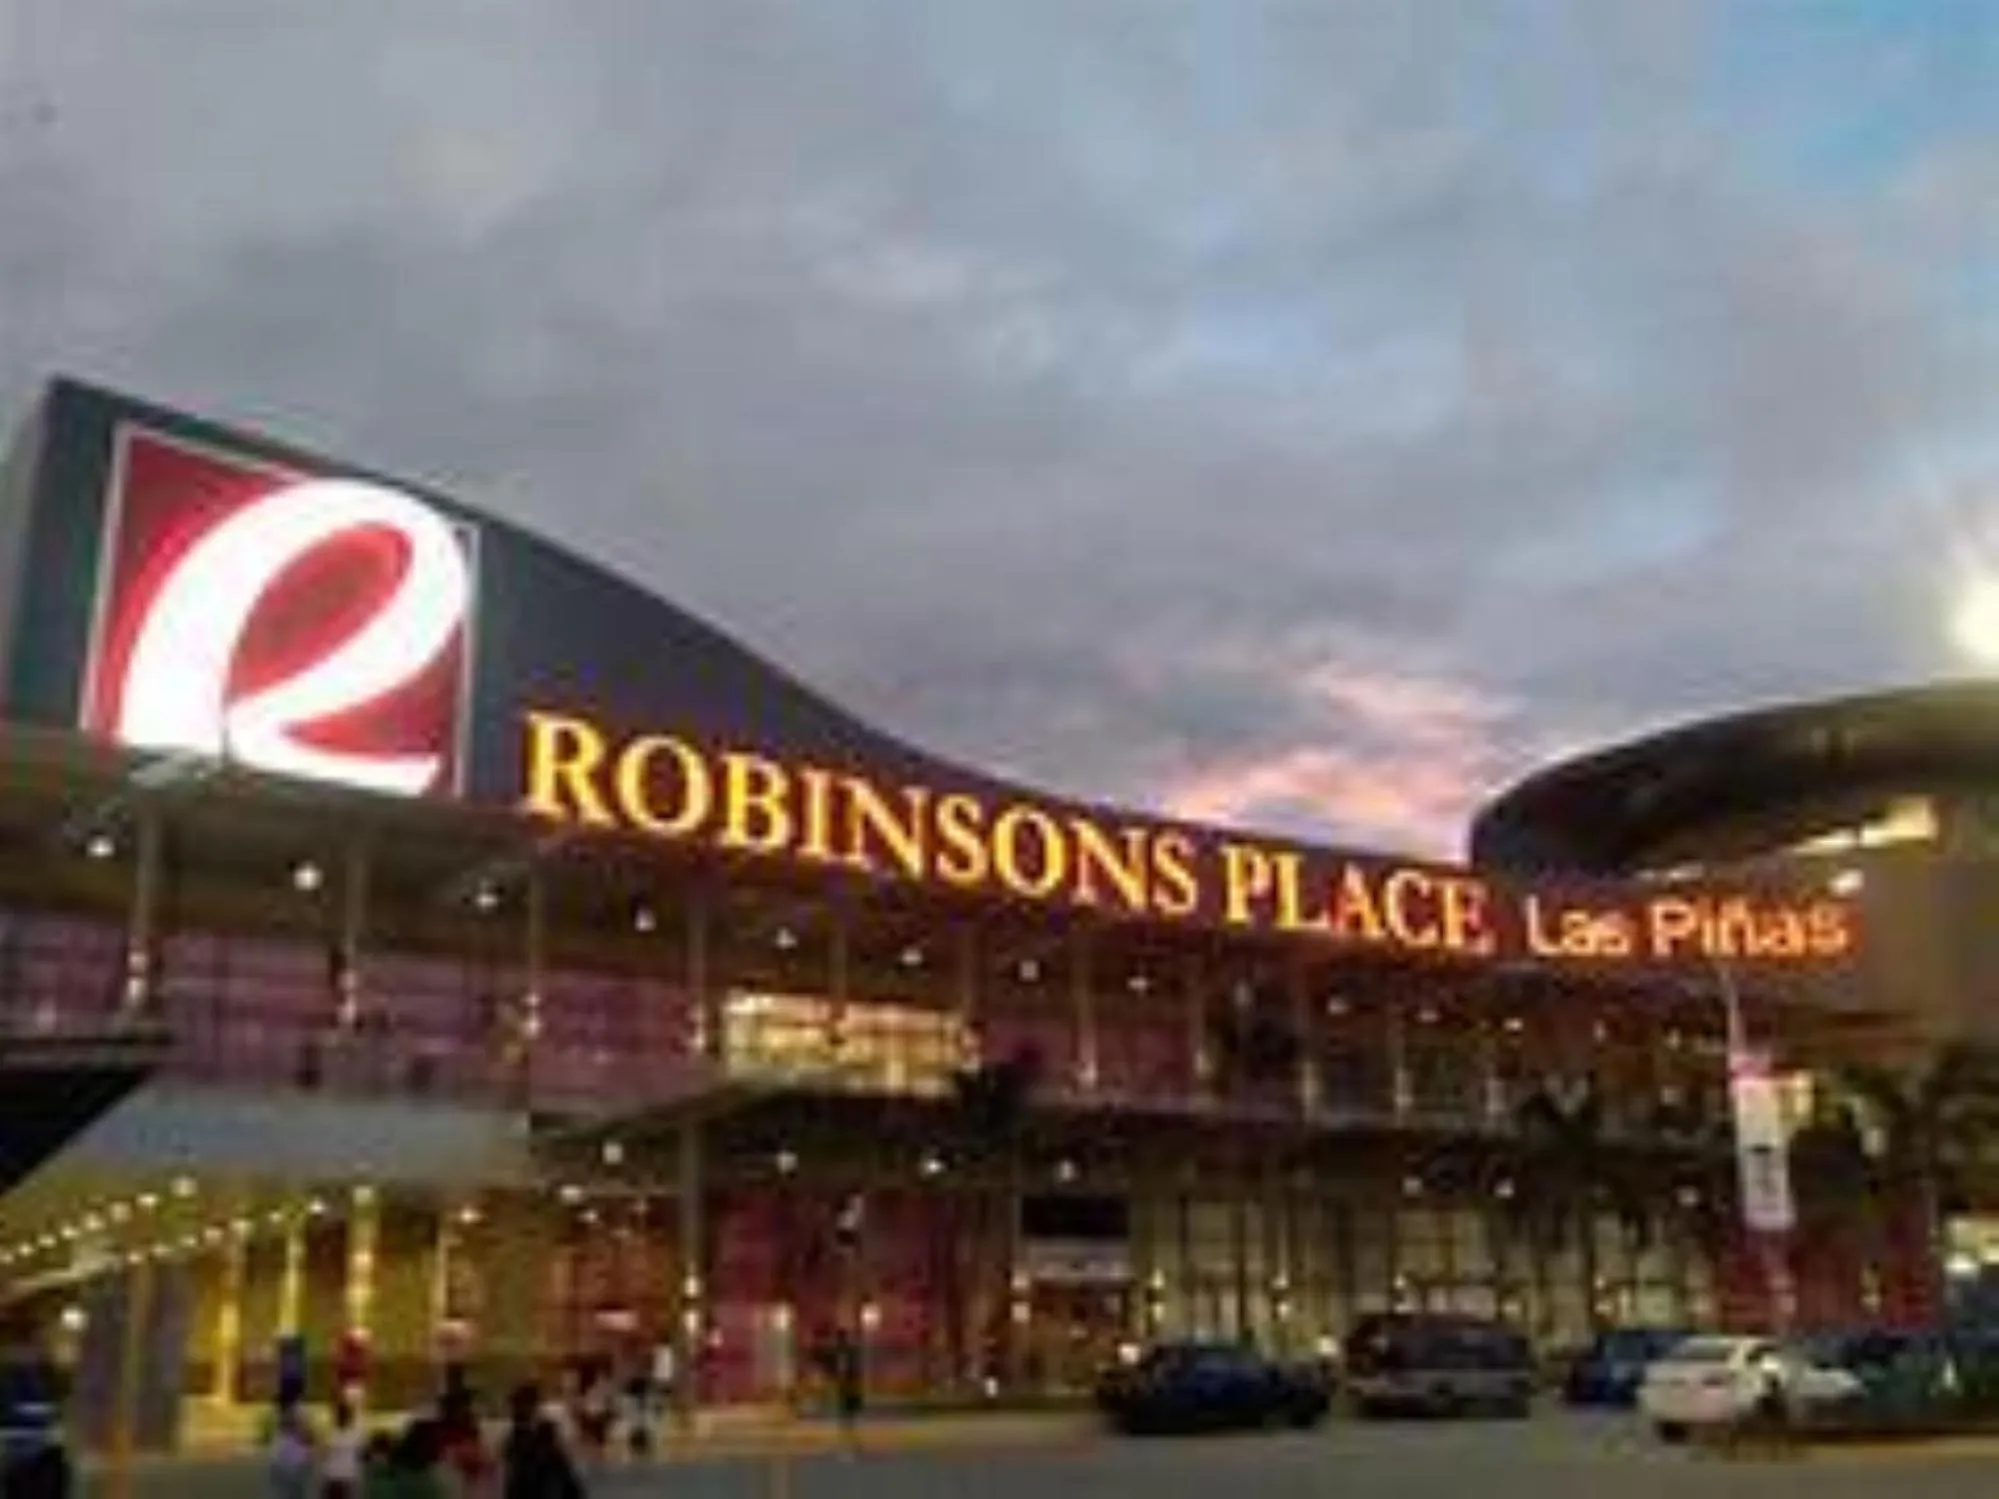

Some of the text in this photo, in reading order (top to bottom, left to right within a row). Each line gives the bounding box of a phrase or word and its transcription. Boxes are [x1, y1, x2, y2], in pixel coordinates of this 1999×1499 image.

[523, 710, 1850, 957] ROBINSONS PLACE Las Piñas
